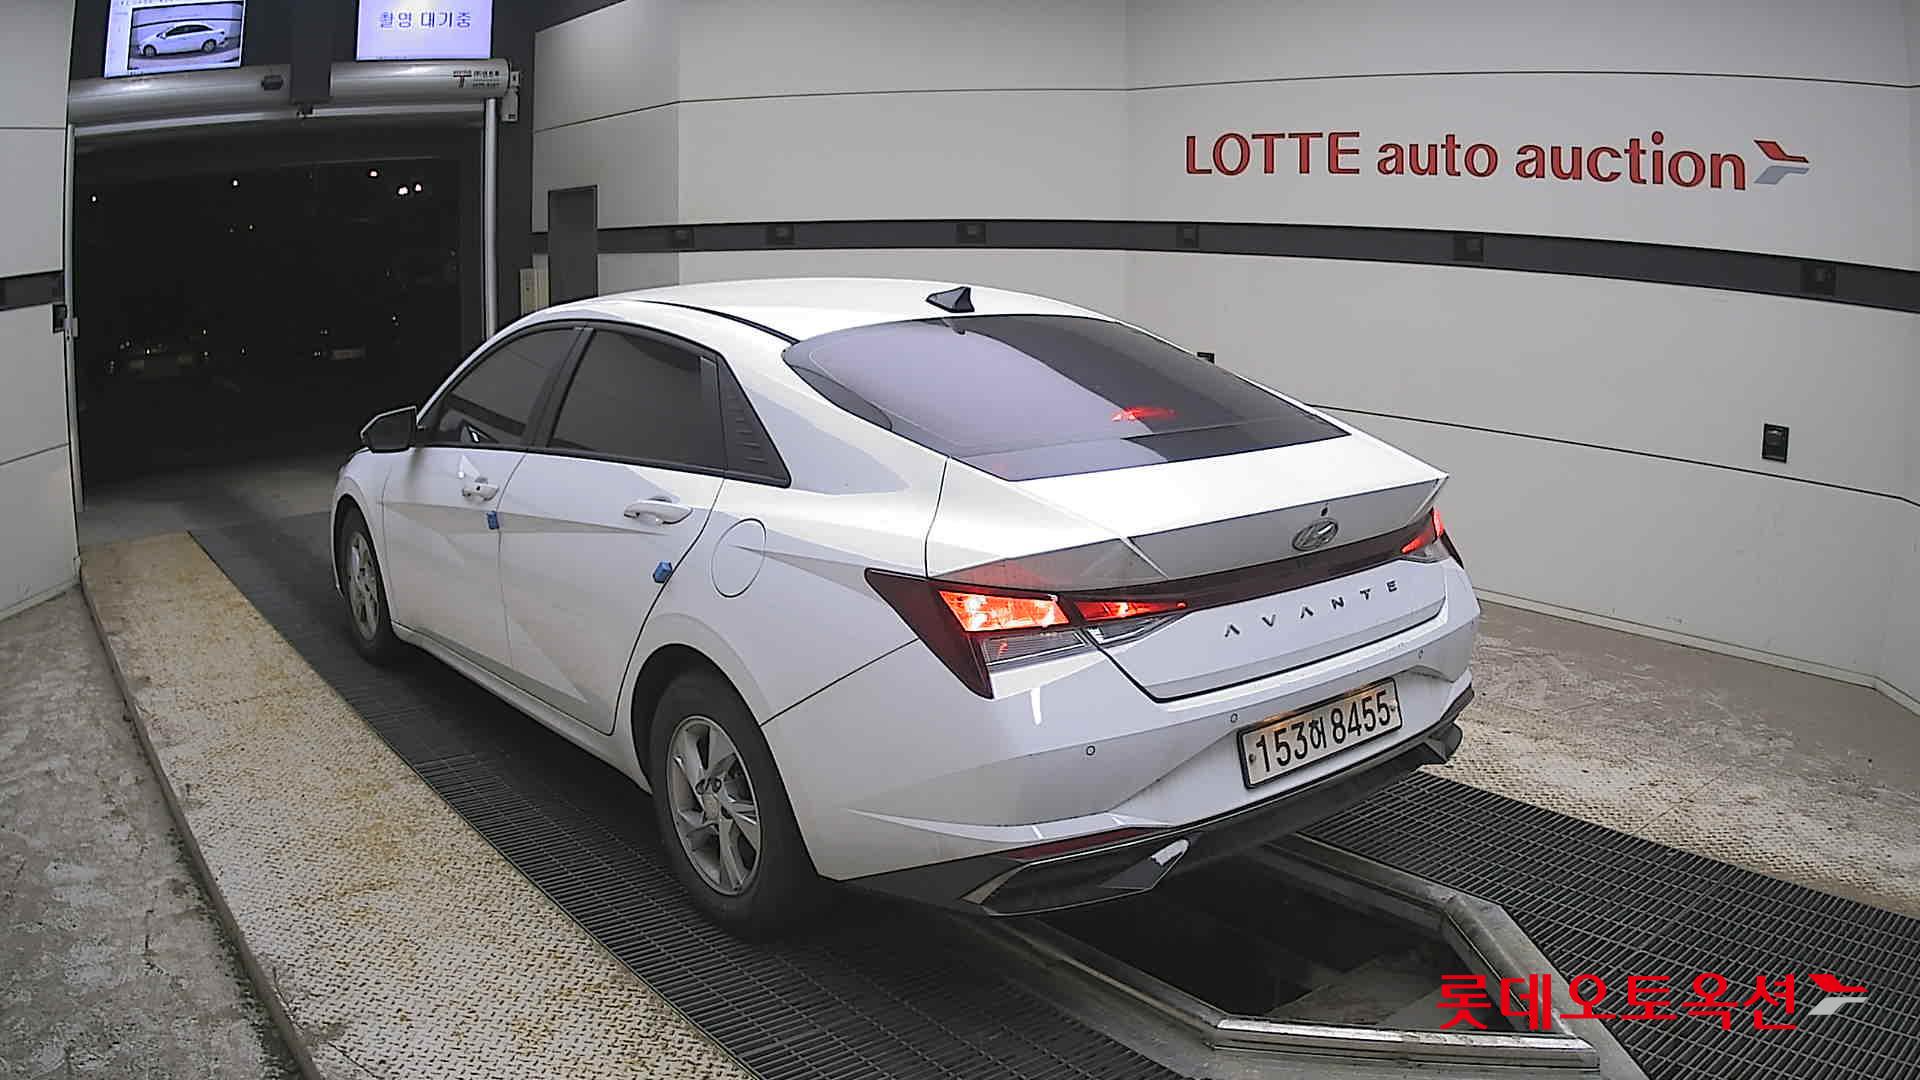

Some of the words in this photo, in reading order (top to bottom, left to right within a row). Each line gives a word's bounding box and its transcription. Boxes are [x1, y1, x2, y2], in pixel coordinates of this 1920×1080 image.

[420, 11, 472, 28] 대기중
[1185, 131, 1361, 176] LOTTE
[1376, 133, 1499, 178] auto
[1514, 130, 1747, 191] auction
[1224, 579, 1399, 638] AVANTE
[1255, 716, 1327, 772] 153허
[1331, 688, 1392, 744] 8455
